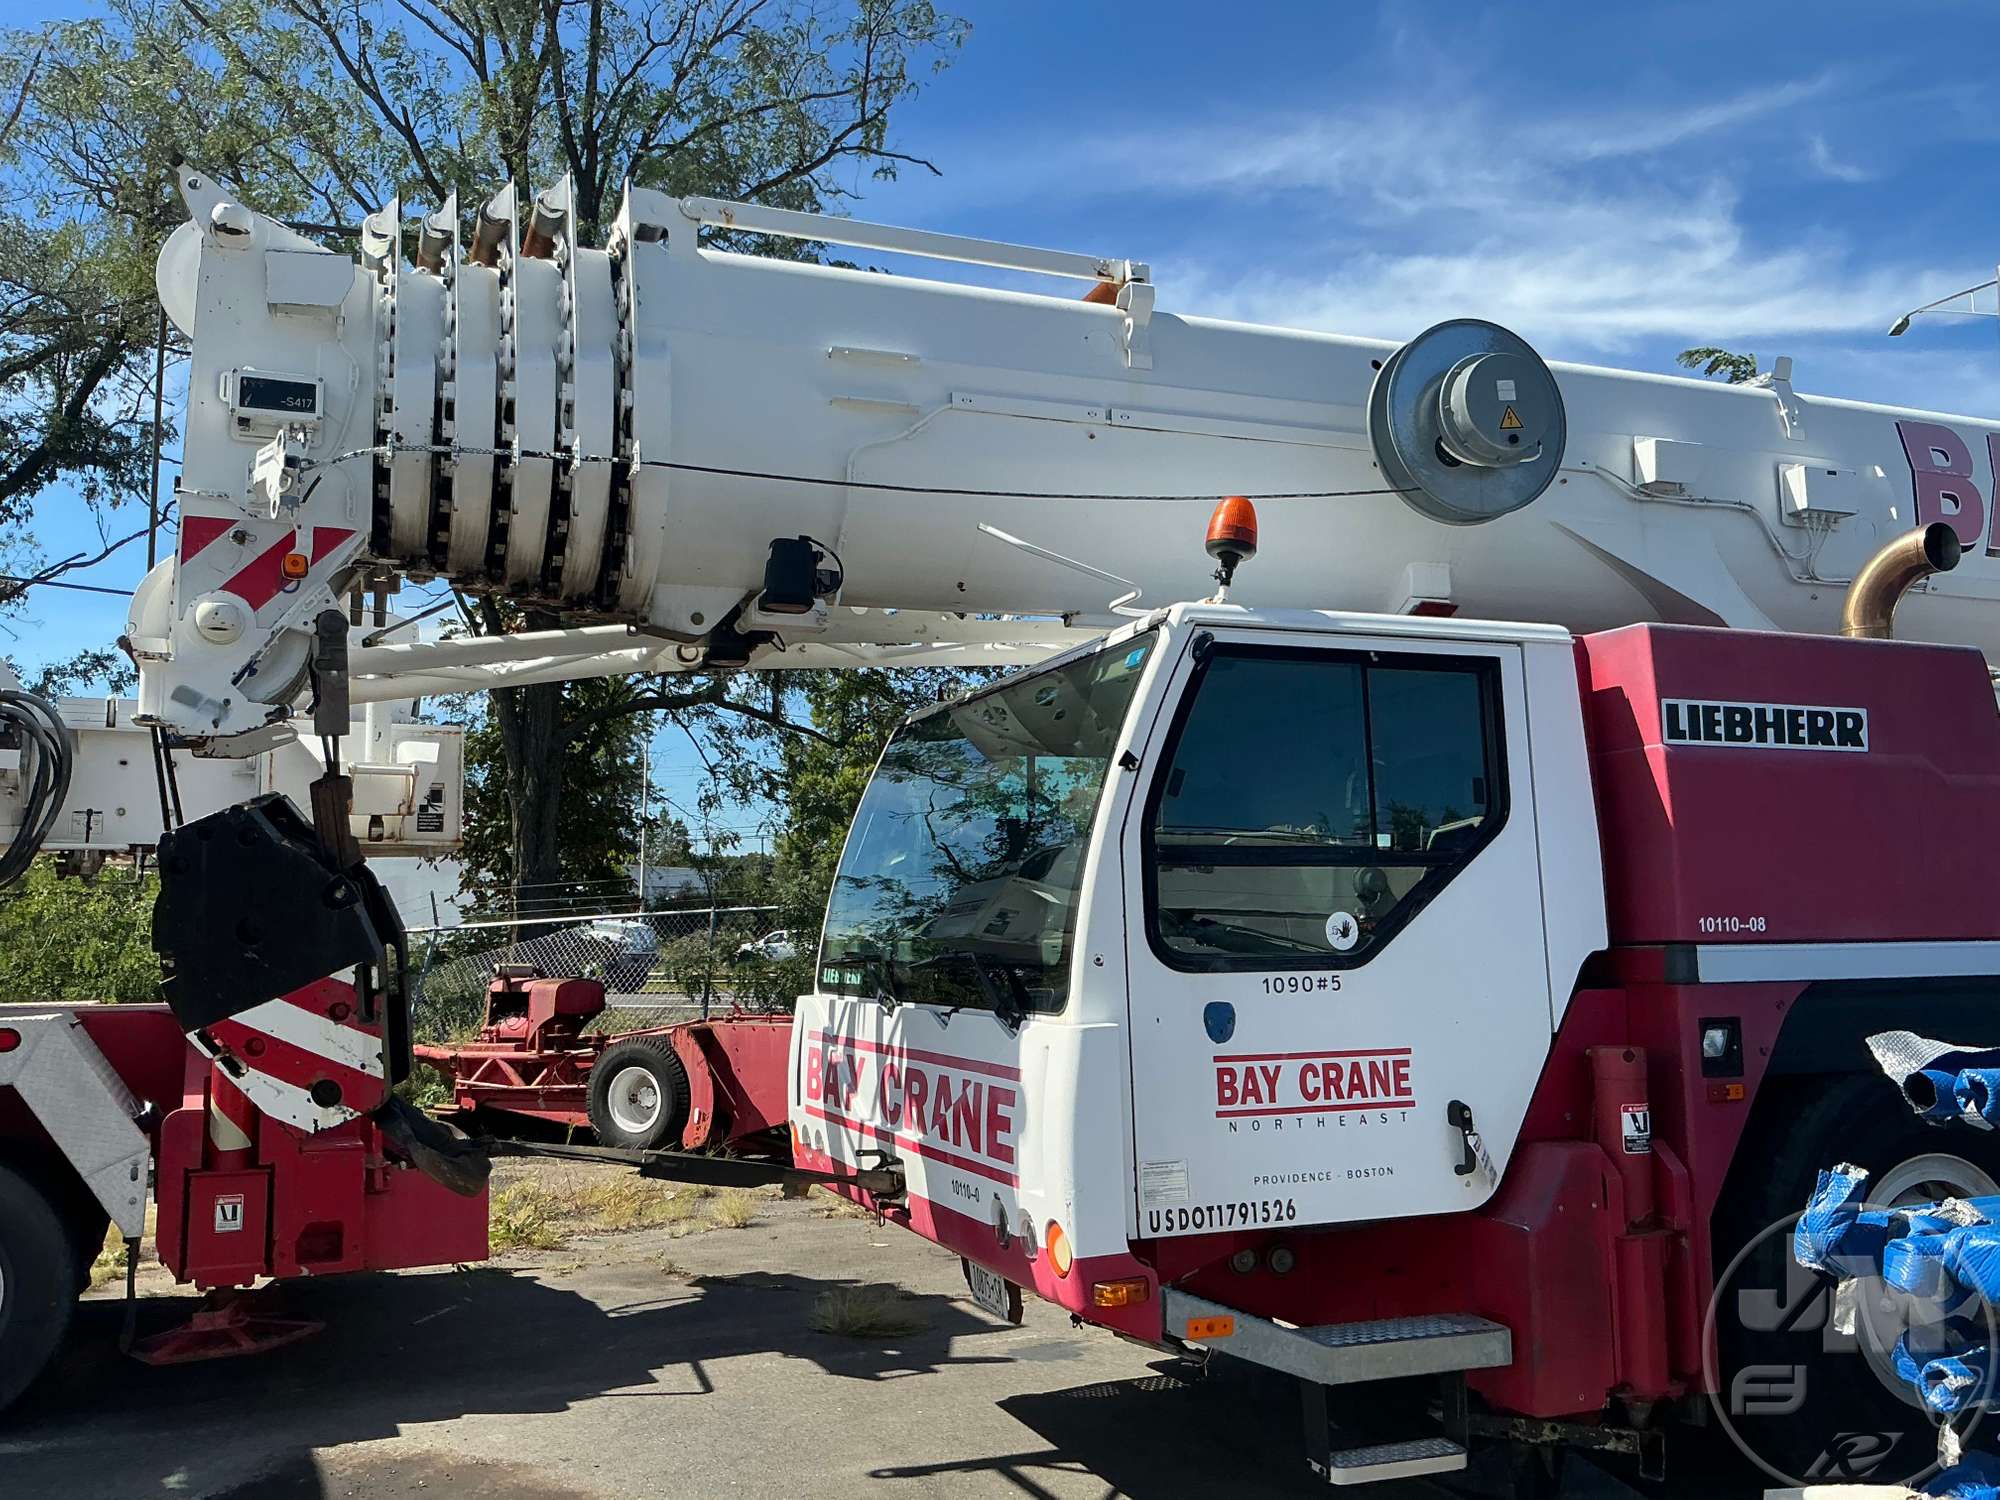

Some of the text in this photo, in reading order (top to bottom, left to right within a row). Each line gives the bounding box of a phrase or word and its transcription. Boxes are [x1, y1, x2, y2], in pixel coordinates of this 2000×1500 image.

[1665, 703, 1865, 748] LIEBHERR
[1262, 975, 1341, 994] 1090#5
[1216, 1059, 1413, 1106] BAY CRANE
[806, 1046, 1017, 1165] BAY CRANE
[1229, 1111, 1407, 1132] NORTHEAST
[1254, 1171, 1332, 1185] PROVIDENCE
[1347, 1166, 1394, 1179] BOSTON
[1149, 1199, 1296, 1233] USDOT1791526
